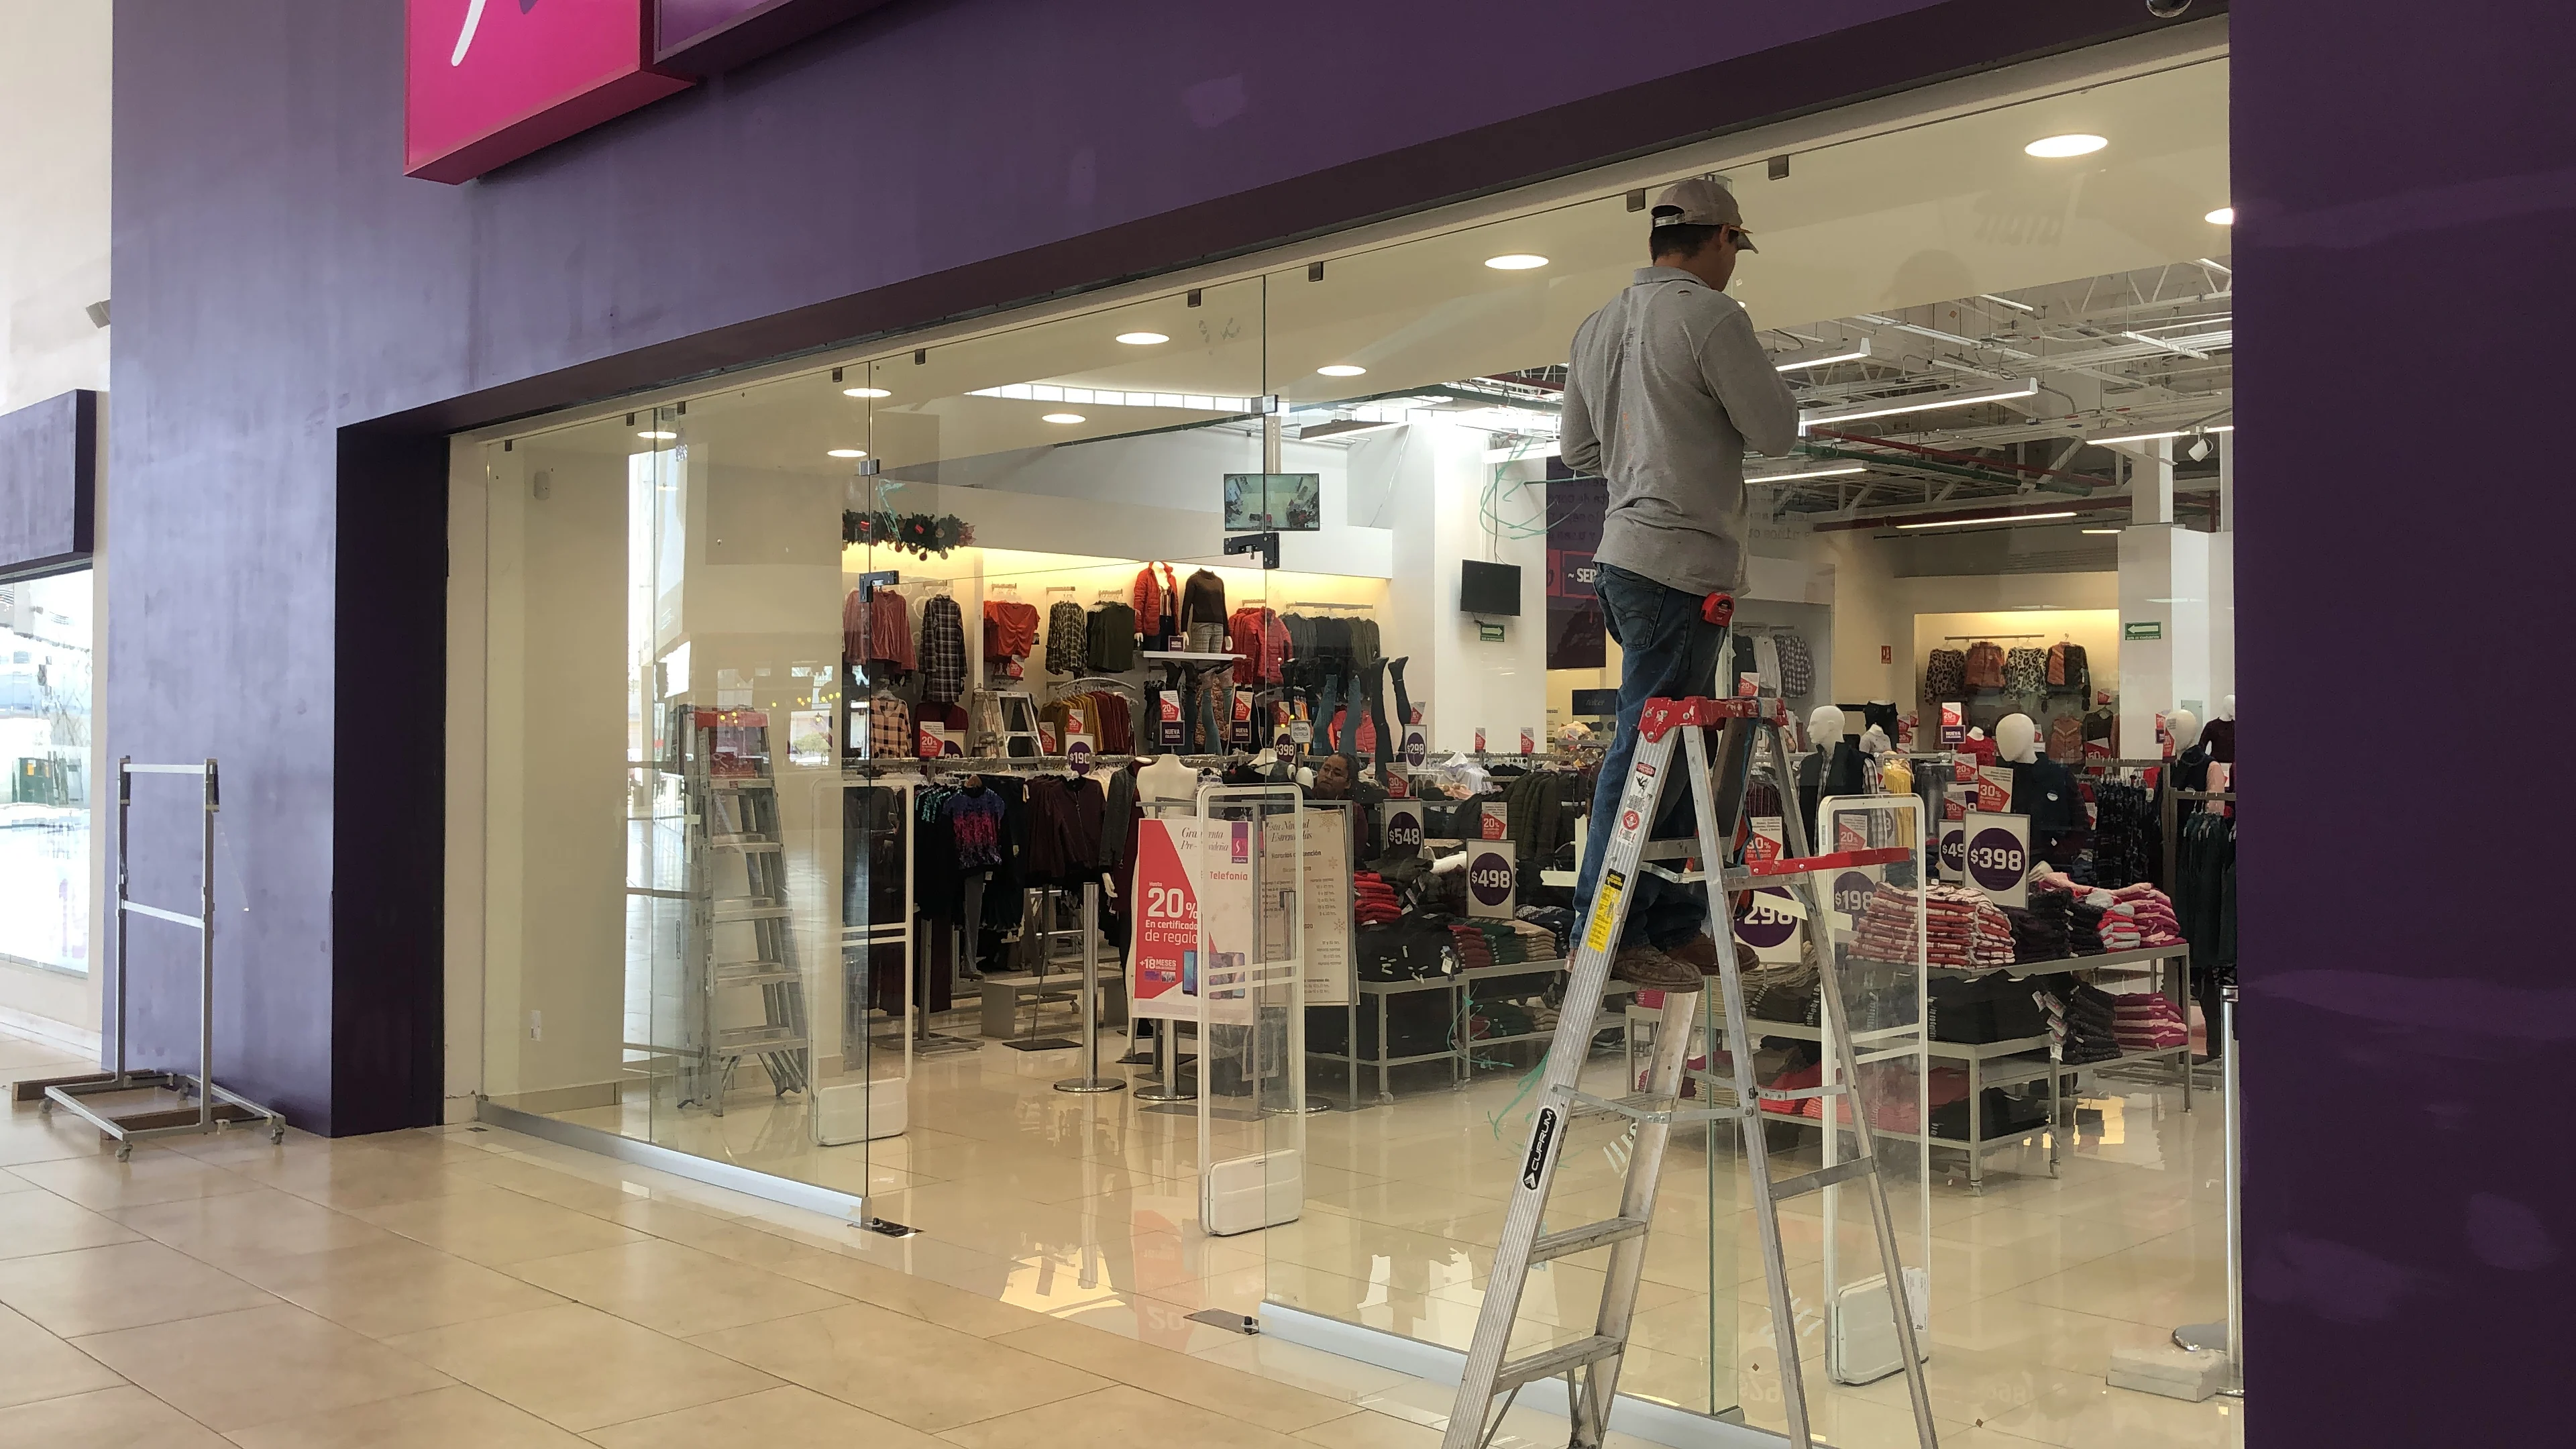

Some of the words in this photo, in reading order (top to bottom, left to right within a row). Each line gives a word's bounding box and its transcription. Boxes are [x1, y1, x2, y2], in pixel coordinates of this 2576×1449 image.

[922, 736, 937, 746] 20%
[1275, 743, 1294, 756] $398
[1407, 743, 1424, 755] $298
[1956, 765, 1970, 773] 20%
[1389, 777, 1403, 786] 30%
[1980, 784, 2001, 798] 30%
[1483, 818, 1499, 828] 20%
[1389, 828, 1419, 845] $548
[1840, 831, 1858, 843] 20%
[1970, 847, 2022, 871] $398
[1210, 871, 1248, 881] Telefonía
[1471, 869, 1511, 888] $498
[1147, 887, 1197, 919] 20%
[1835, 890, 1874, 911] $198
[1736, 906, 1793, 924] 298
[1145, 920, 1155, 928] En
[1144, 929, 1160, 941] de
[1163, 931, 1197, 946] regalo
[1139, 958, 1156, 969] +18
[1156, 959, 1177, 967] MESES
[1532, 1110, 1553, 1171] CUPRUM
